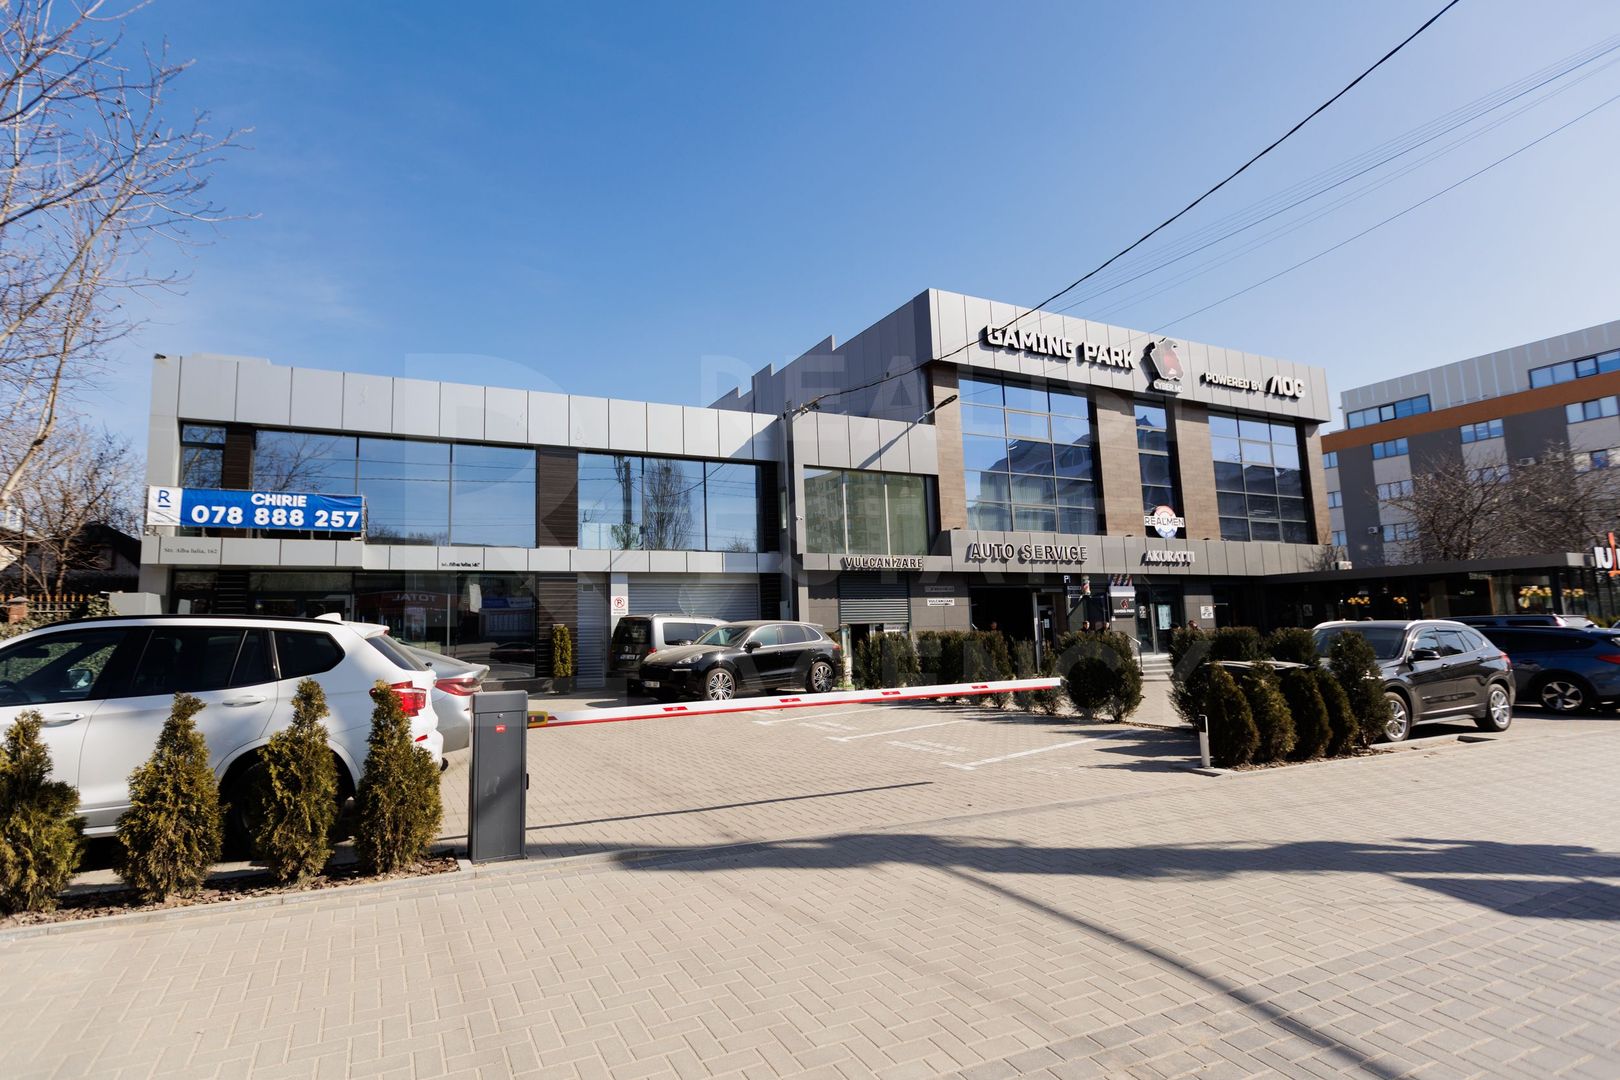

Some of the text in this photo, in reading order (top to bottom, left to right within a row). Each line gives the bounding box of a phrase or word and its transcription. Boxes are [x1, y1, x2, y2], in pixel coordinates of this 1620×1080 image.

[986, 322, 1135, 369] GAMING PARK
[1204, 372, 1250, 389] POWERED
[1251, 379, 1263, 391] BY
[250, 493, 307, 508] CHIRIE
[191, 505, 360, 528] 078 888 257
[970, 543, 1088, 562] AUTO SERVICE
[1145, 550, 1197, 563] AKURATTI
[844, 556, 924, 569] VULCANIZARE
